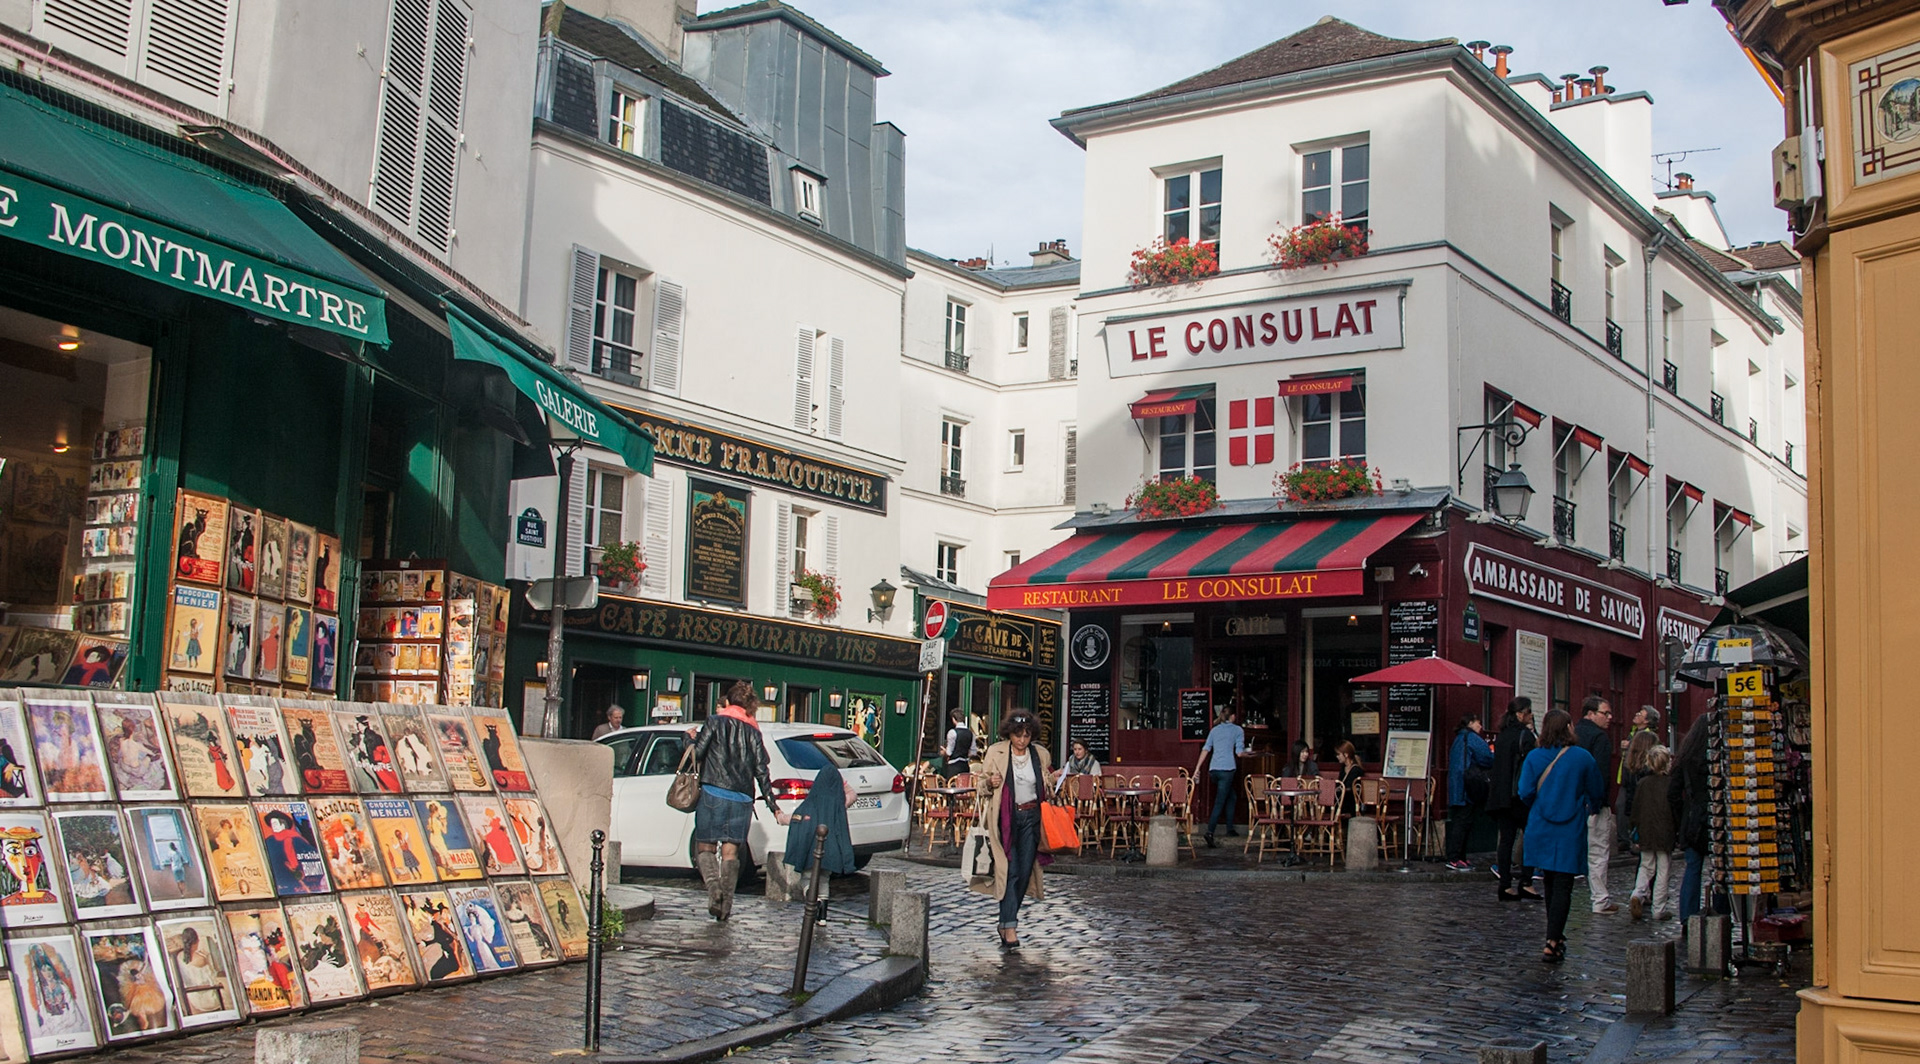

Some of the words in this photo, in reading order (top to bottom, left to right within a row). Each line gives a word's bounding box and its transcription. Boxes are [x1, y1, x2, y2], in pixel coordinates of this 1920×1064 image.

[48, 202, 369, 334] MONTMARTRE
[1128, 325, 1168, 362] LE
[1184, 299, 1377, 354] CONSULAT
[1287, 384, 1299, 393] LE
[1299, 380, 1343, 391] CONSULAT
[535, 379, 600, 439] GALERIE
[1140, 402, 1187, 416] RESTAURANT
[720, 441, 873, 504] FRANQUETTE
[527, 521, 537, 529] RUE
[178, 587, 215, 600] CHOCOLAT
[1023, 588, 1123, 606] RESTAURANT
[1163, 581, 1190, 600] LE
[1199, 574, 1318, 599] CONSULAT
[1472, 556, 1565, 606] AMBASSADE
[1575, 585, 1591, 614] DE
[1600, 595, 1641, 628] SAVOIE
[176, 595, 216, 609] MENIER
[600, 603, 668, 637] CAFÉ
[677, 612, 828, 657] RESTAURANT
[835, 636, 878, 663] VINS
[973, 623, 1009, 648] CAVE
[1011, 632, 1023, 648] DE
[1661, 616, 1706, 645] RESTAUR
[925, 640, 938, 650] SAUF
[1734, 676, 1757, 693] 5€
[369, 801, 406, 809] CHOCOLAT
[369, 808, 411, 818] MENIER
[450, 851, 477, 865] MAGGI
